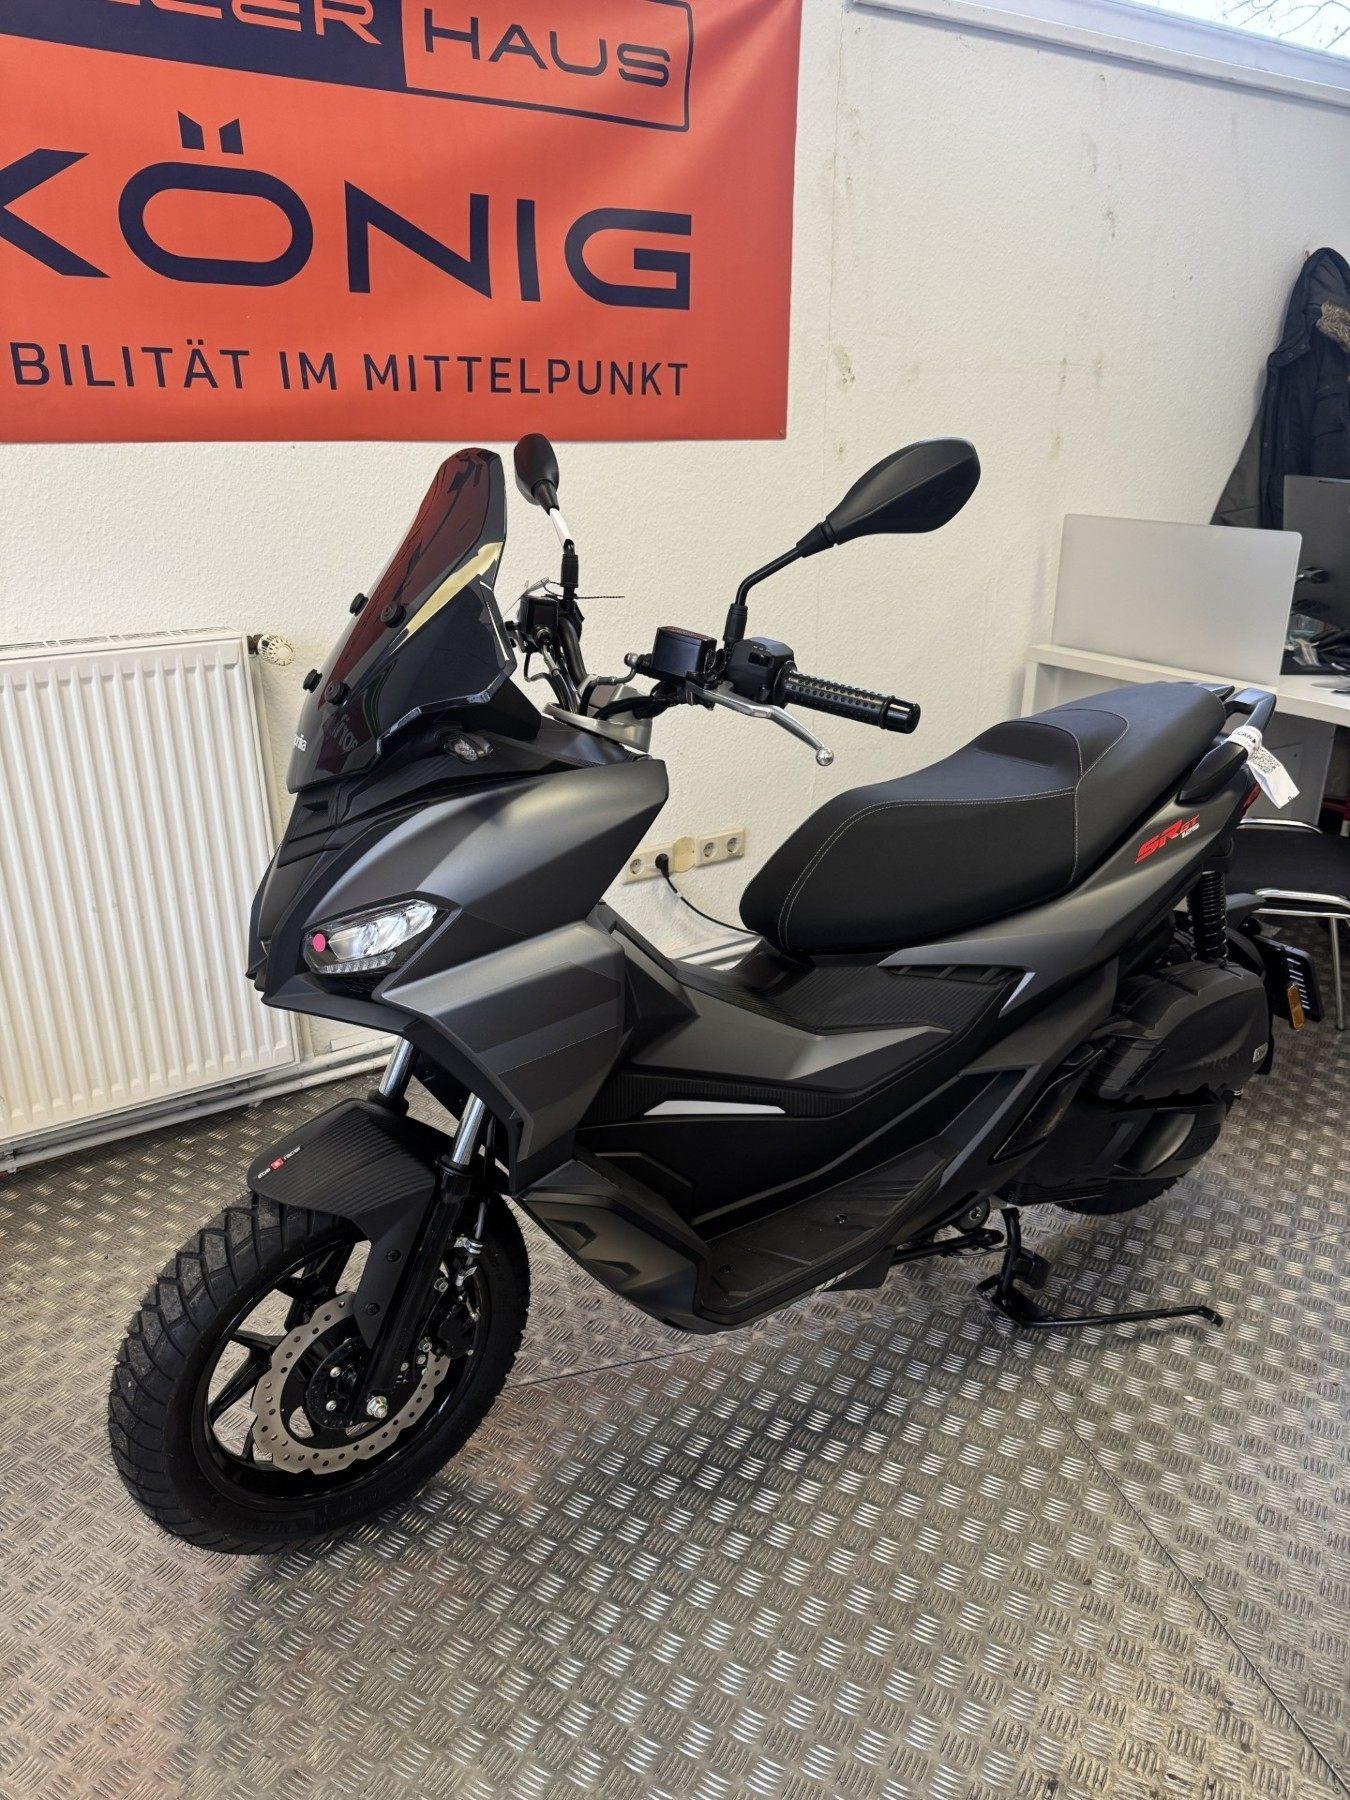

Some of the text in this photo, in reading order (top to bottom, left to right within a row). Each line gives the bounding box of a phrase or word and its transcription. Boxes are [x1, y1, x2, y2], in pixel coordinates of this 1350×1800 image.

[424, 7, 671, 88] HAUS
[0, 111, 692, 311] KÖNIG
[9, 339, 689, 396] BILITÄT IM MITTELPUNKT
